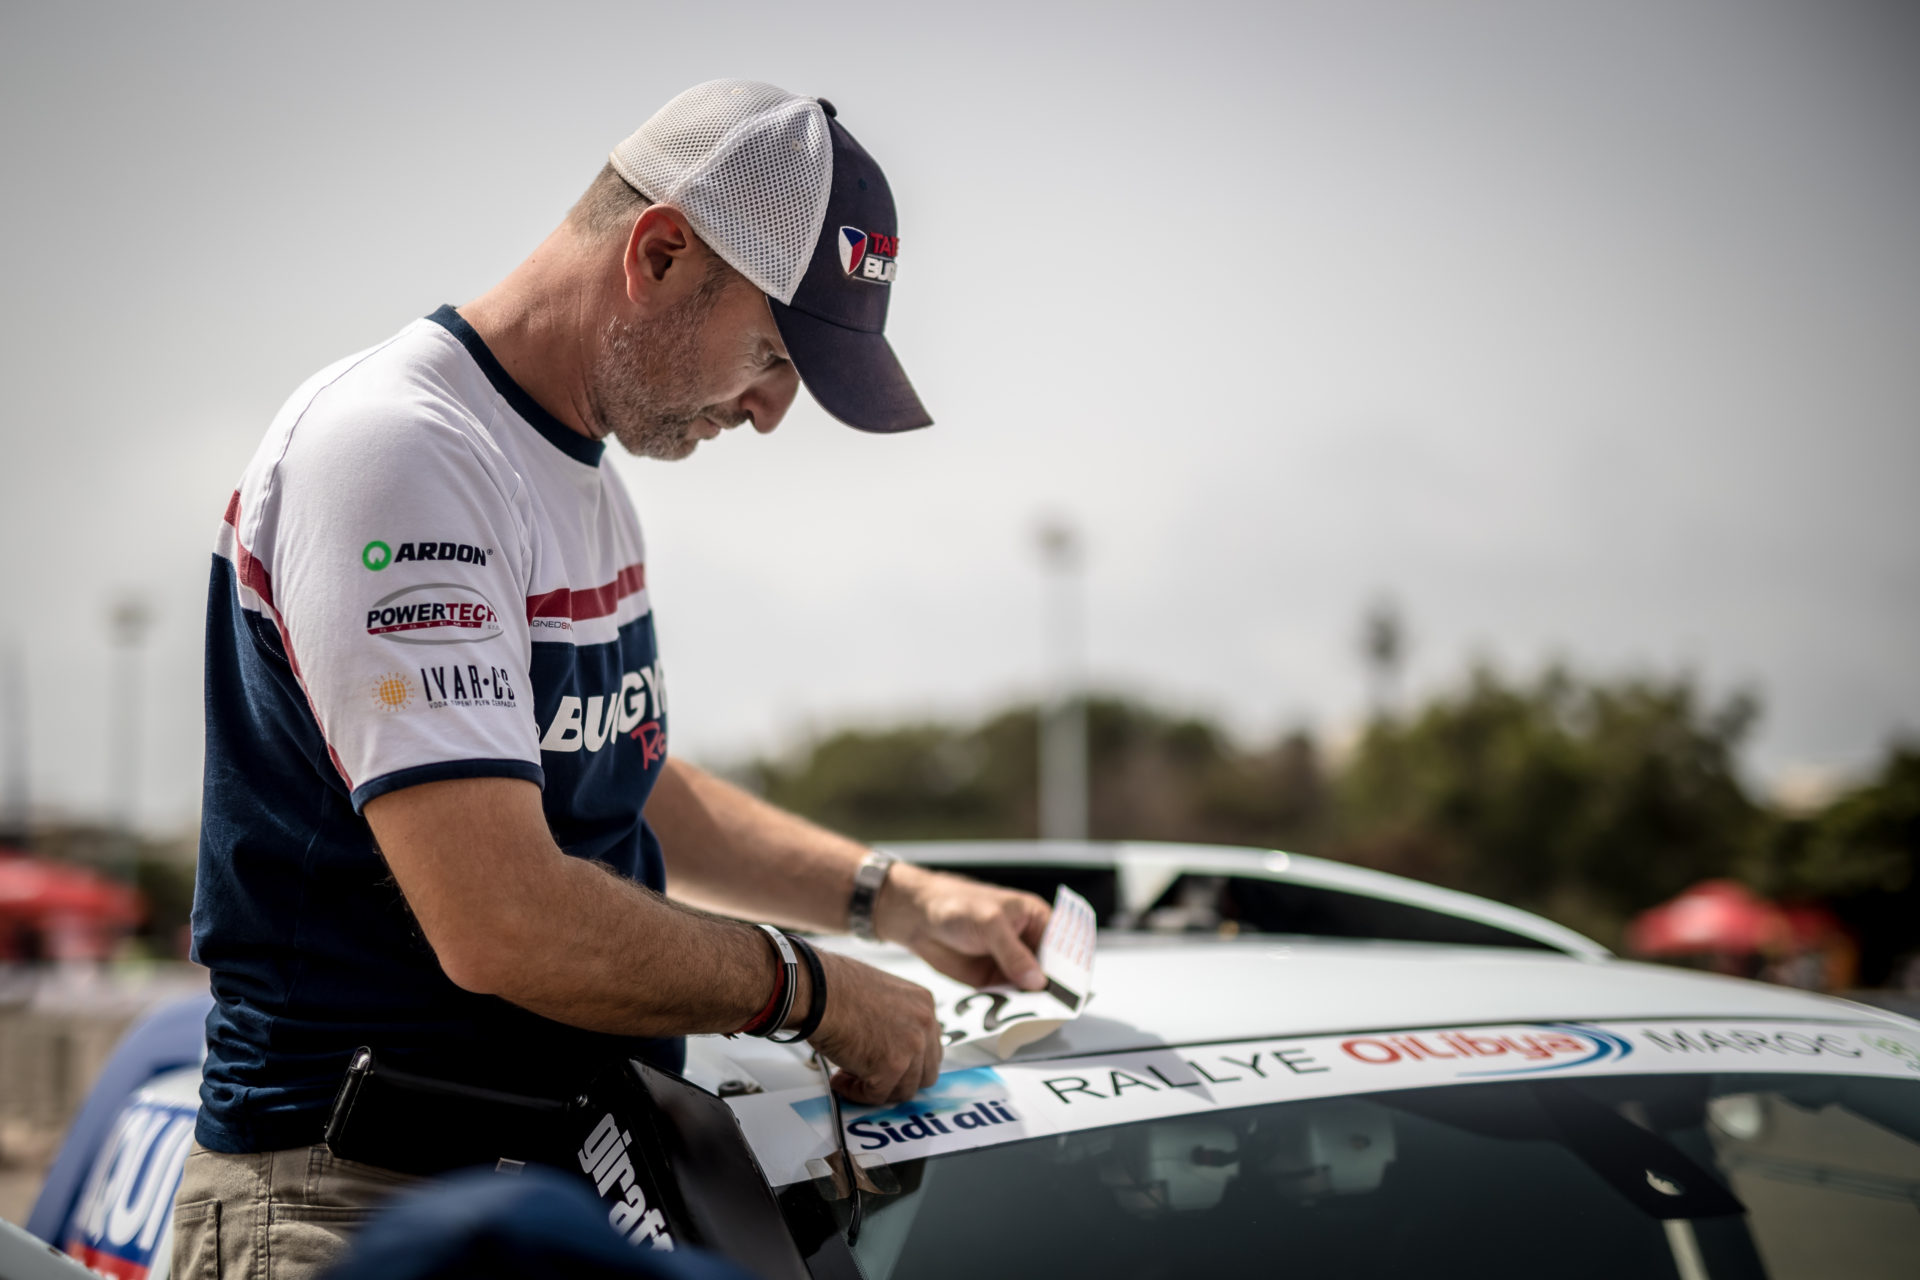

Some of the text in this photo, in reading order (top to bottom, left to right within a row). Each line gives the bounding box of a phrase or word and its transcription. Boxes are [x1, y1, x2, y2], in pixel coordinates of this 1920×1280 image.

[1042, 1048, 1331, 1104] RALLYE
[1639, 1028, 1863, 1058] MAROC
[846, 1101, 1018, 1150] Sidi ali
